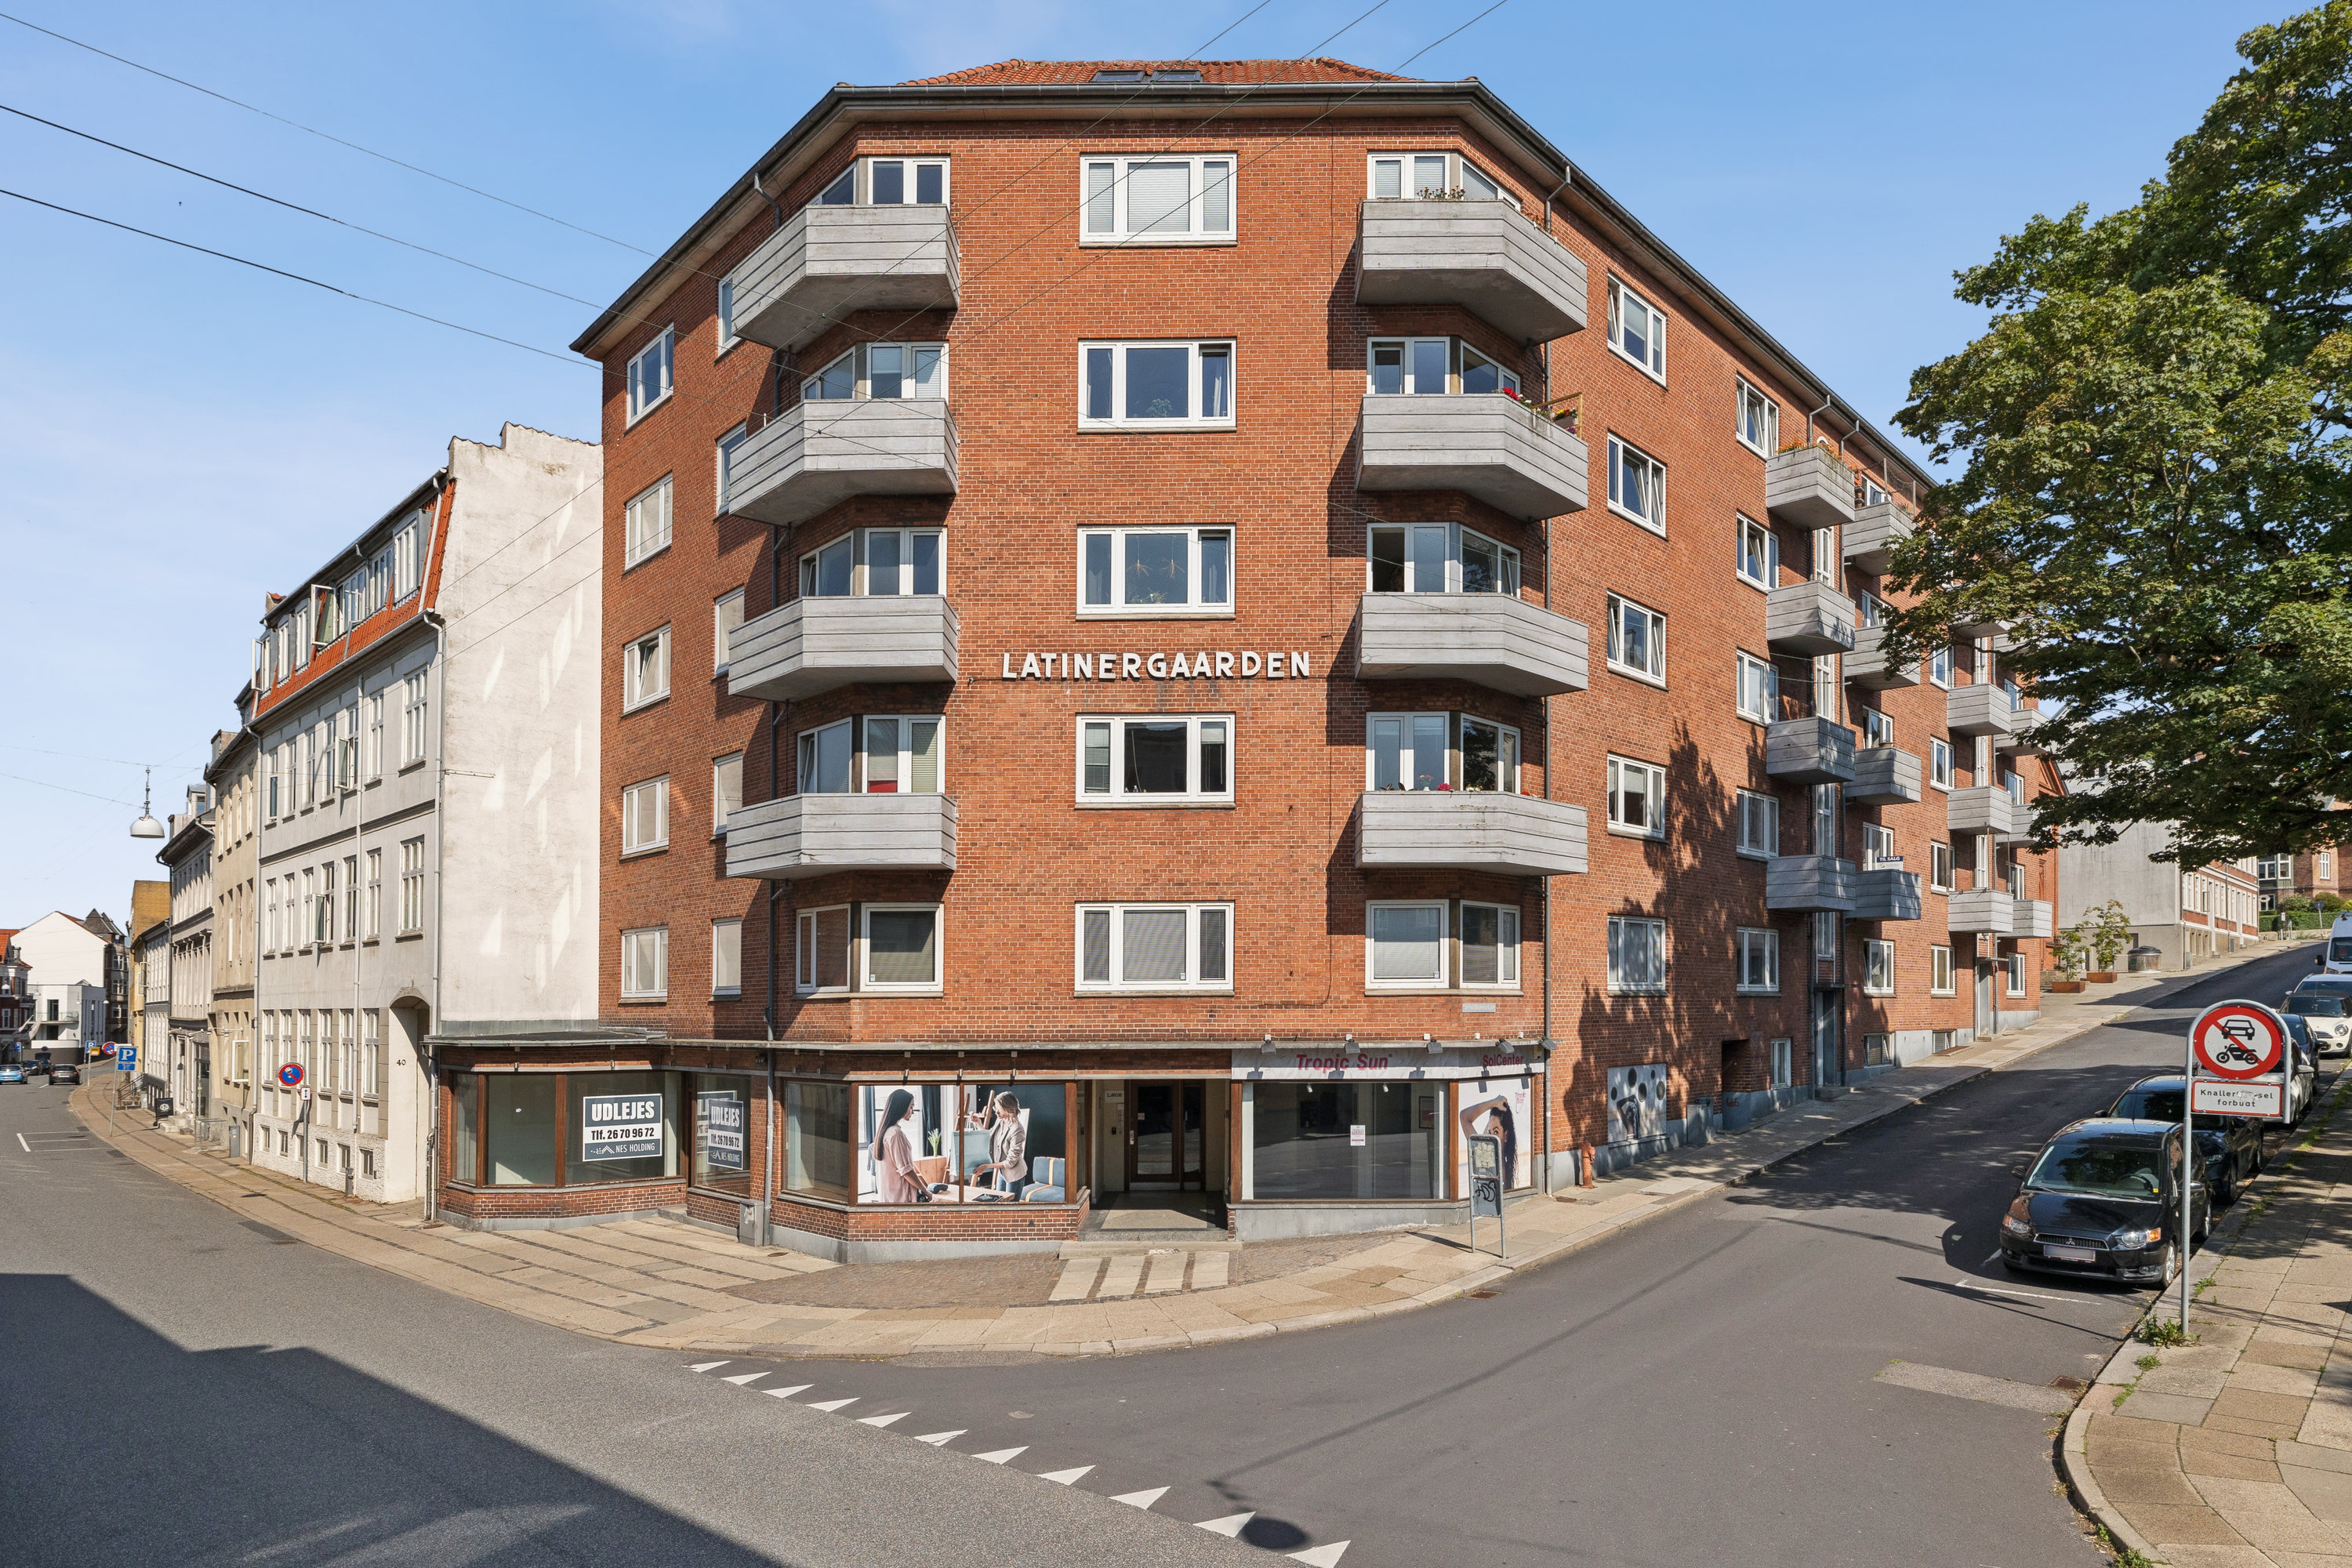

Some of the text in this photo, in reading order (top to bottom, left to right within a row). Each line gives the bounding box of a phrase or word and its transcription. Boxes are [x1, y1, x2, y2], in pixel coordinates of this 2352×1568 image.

[1002, 651, 1310, 679] LATINERGAARDEN
[121, 1049, 134, 1061] P
[1483, 1054, 1524, 1067] SolCenter
[1296, 1054, 1349, 1073] Tropic
[591, 1101, 655, 1122] UDLEJES
[711, 1105, 740, 1127] UDLEJES
[591, 1127, 655, 1141] Tlf. 26 70 96 72
[615, 1142, 655, 1153] NES HOLDING
[734, 1138, 739, 1148] 72
